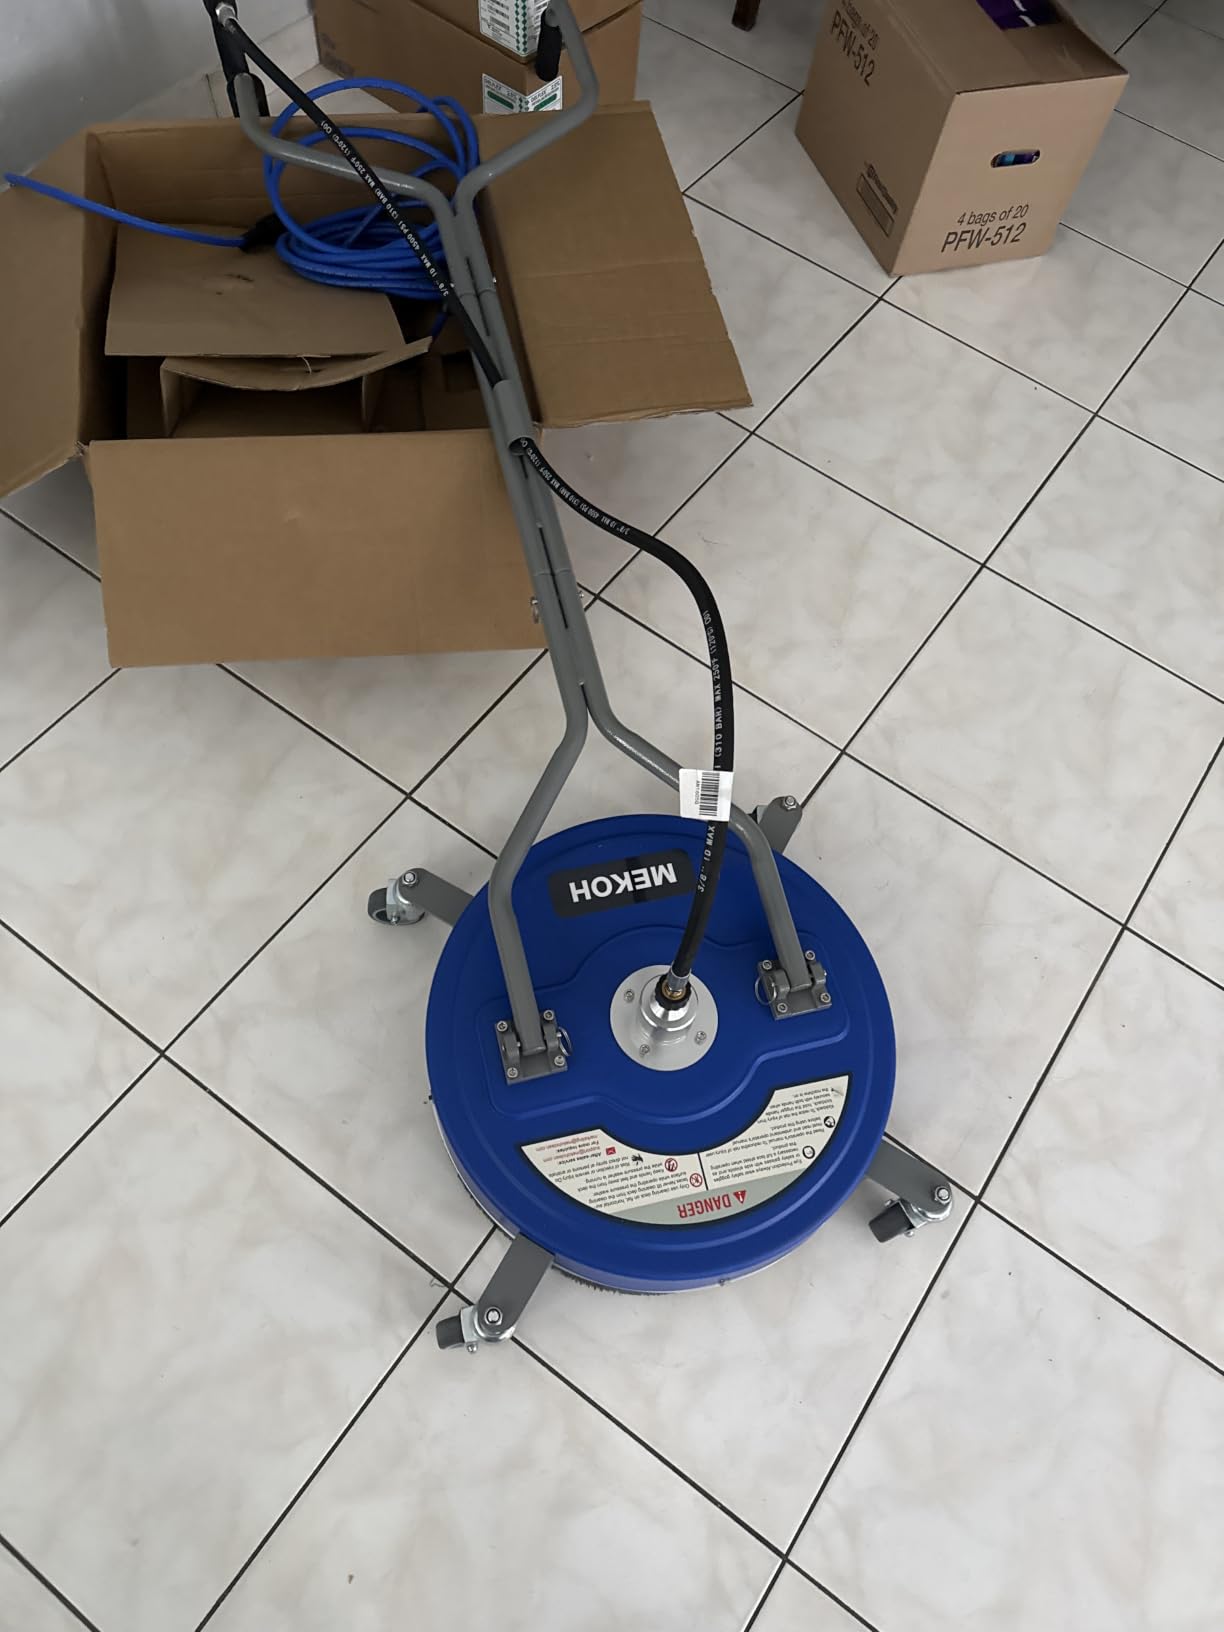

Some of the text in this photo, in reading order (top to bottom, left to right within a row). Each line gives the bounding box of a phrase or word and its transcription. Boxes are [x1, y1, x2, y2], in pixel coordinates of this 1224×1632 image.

[831, 9, 875, 86] PFW-512
[365, 174, 375, 187] MAX
[375, 188, 387, 204] BAR)
[386, 204, 398, 219] (310
[957, 203, 1029, 227] 4 bags of 20
[407, 234, 419, 250] 4500
[941, 222, 1027, 252] PFW-512
[421, 254, 431, 268] MAX
[550, 479, 560, 488] MAX
[560, 488, 570, 498] BAR)
[569, 495, 579, 505] (310
[588, 509, 599, 518] 4500
[601, 516, 610, 525] MAX
[715, 706, 723, 730] BAR)
[714, 733, 723, 758] (310
[706, 825, 716, 846] MAX
[703, 848, 712, 861] ID
[568, 862, 678, 903] MEKOH
[638, 1178, 658, 1186] operating
[713, 1174, 730, 1182] goggles
[610, 1184, 629, 1192] pressure
[678, 1194, 731, 1218] DANGER
